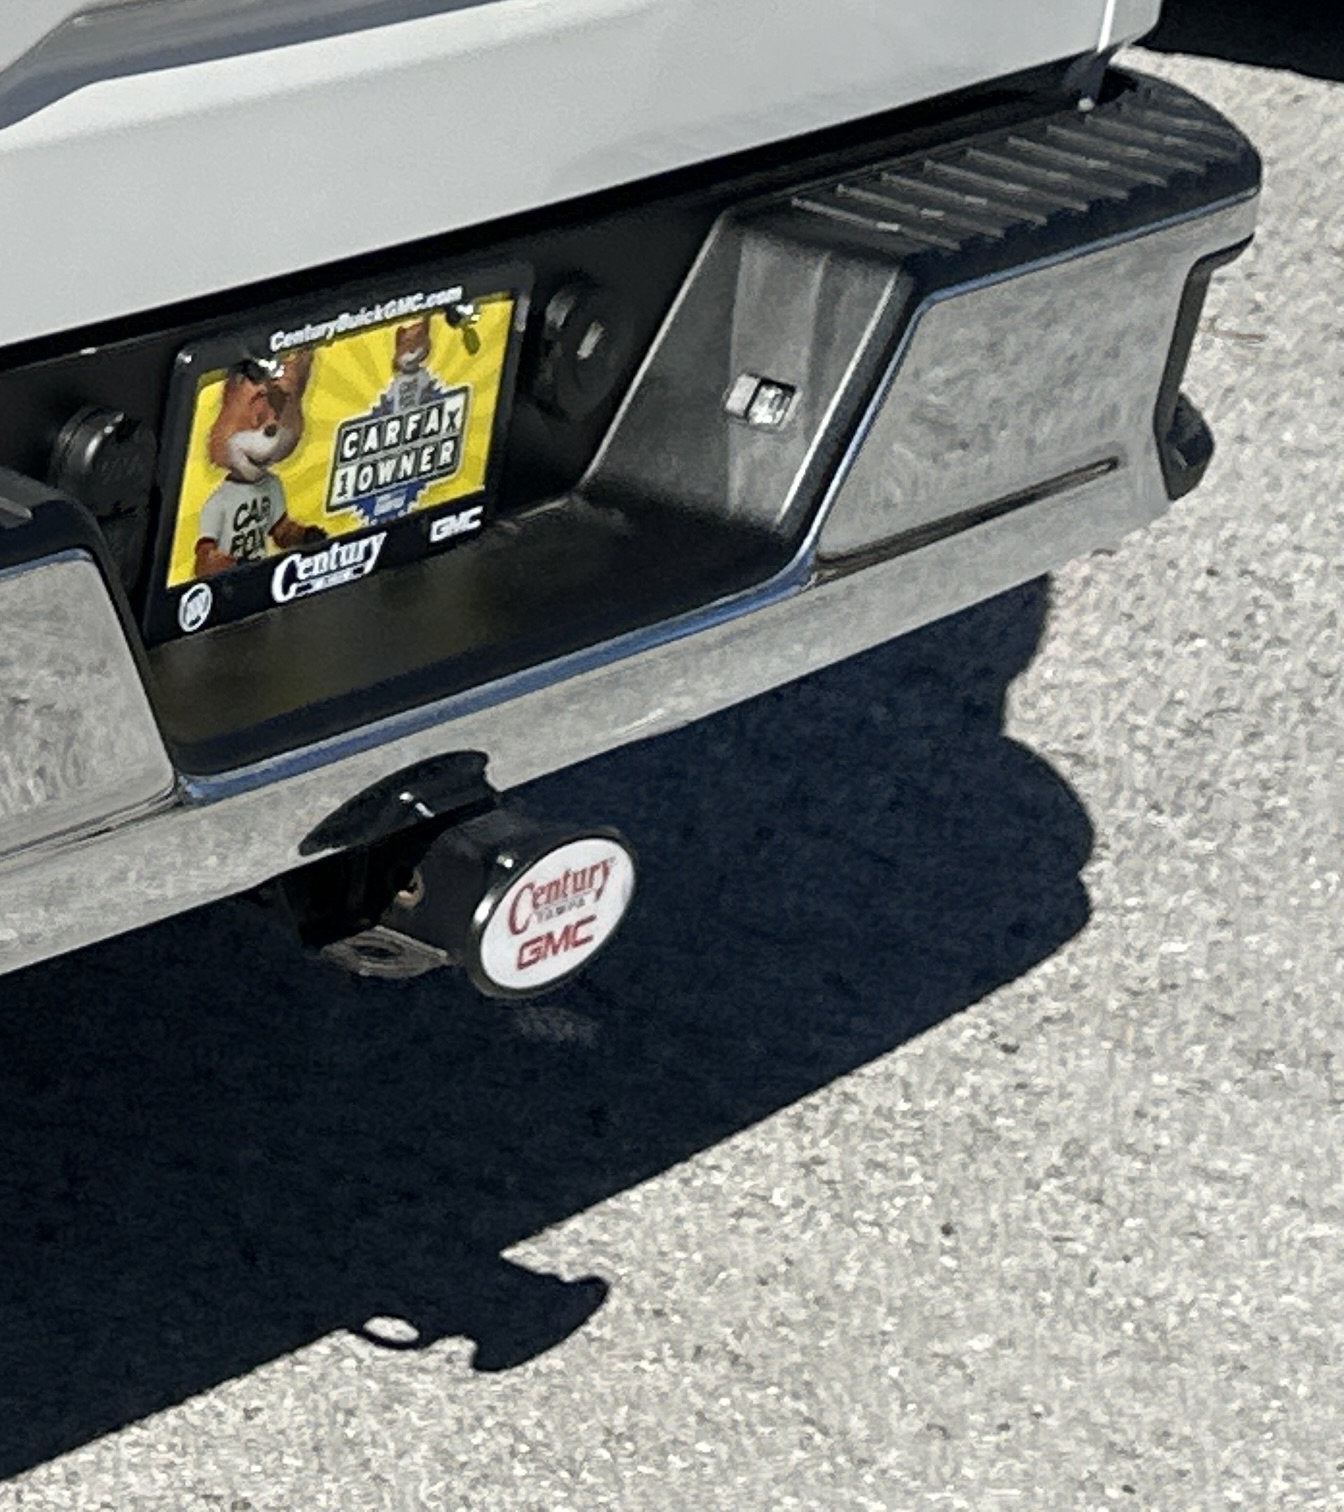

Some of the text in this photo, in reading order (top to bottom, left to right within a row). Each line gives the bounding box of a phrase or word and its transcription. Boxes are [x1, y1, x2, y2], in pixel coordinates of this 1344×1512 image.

[270, 285, 463, 352] CenturyBuickGMC.com
[342, 406, 462, 459] CARFAX
[357, 439, 455, 492] OWNER
[429, 505, 484, 542] GMC
[271, 530, 387, 603] Century
[508, 856, 616, 936] Century
[517, 914, 598, 971] GMC
